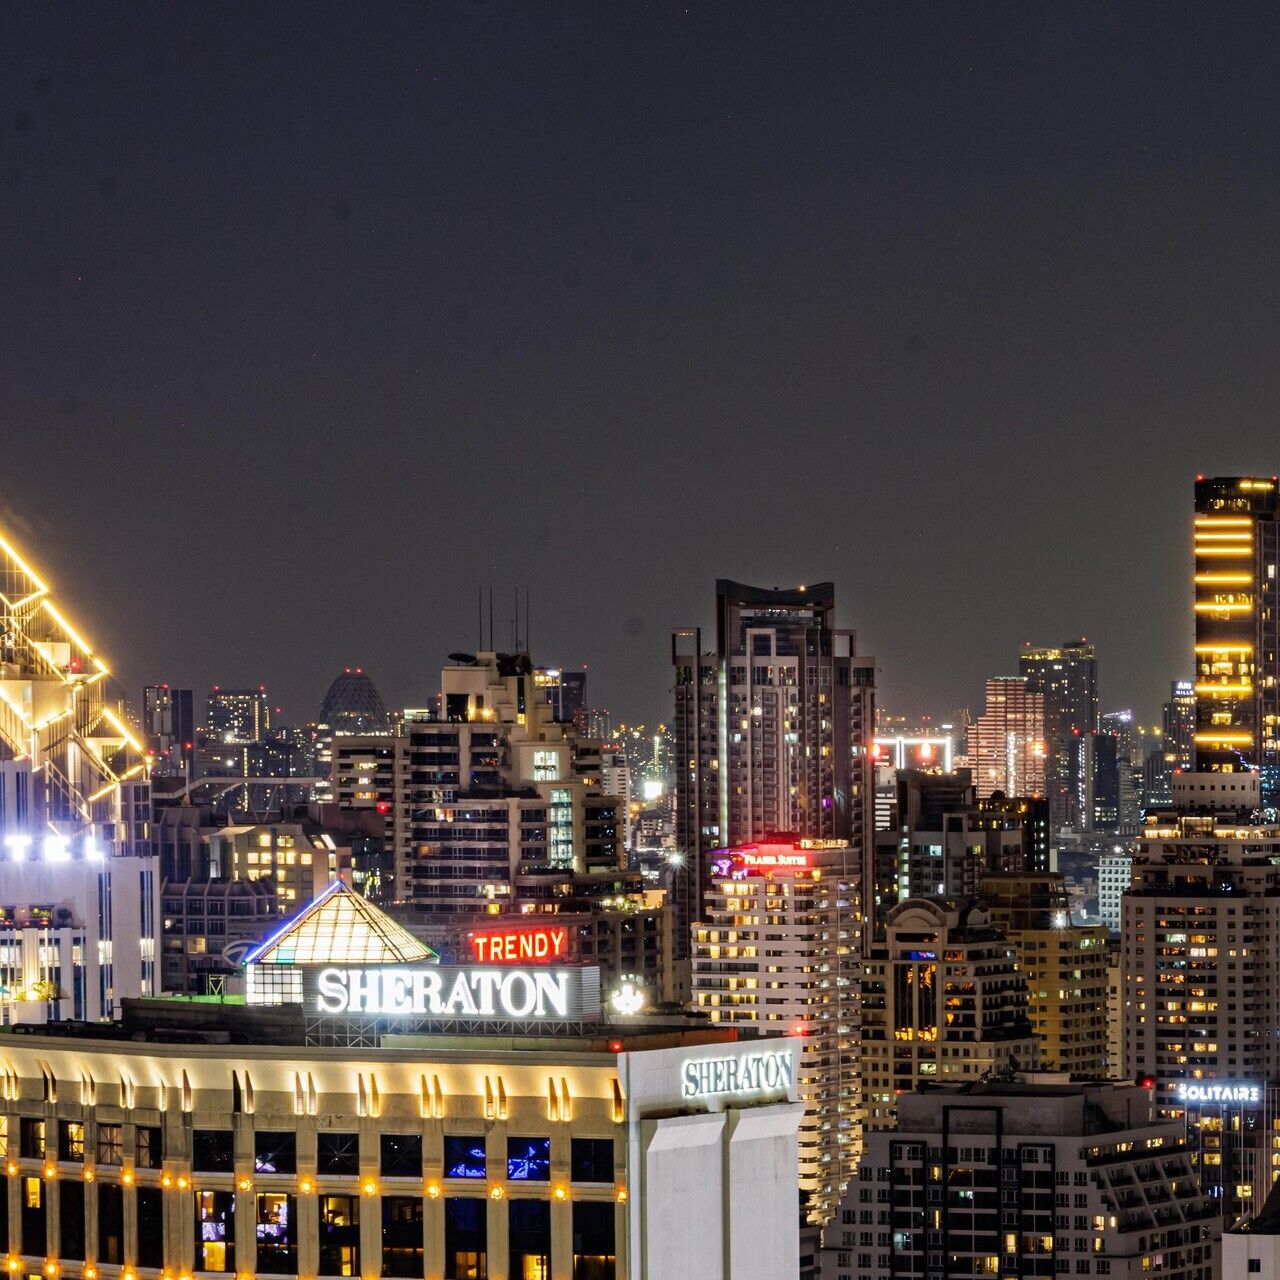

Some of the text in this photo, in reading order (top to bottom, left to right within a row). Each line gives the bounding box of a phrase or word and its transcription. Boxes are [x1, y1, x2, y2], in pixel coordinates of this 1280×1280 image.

[778, 854, 807, 865] SUITES
[474, 931, 564, 962] TRENDY
[317, 968, 569, 1017] SHERATON
[684, 1053, 793, 1097] SHERATON
[1178, 1085, 1260, 1102] SOLITAIRE
